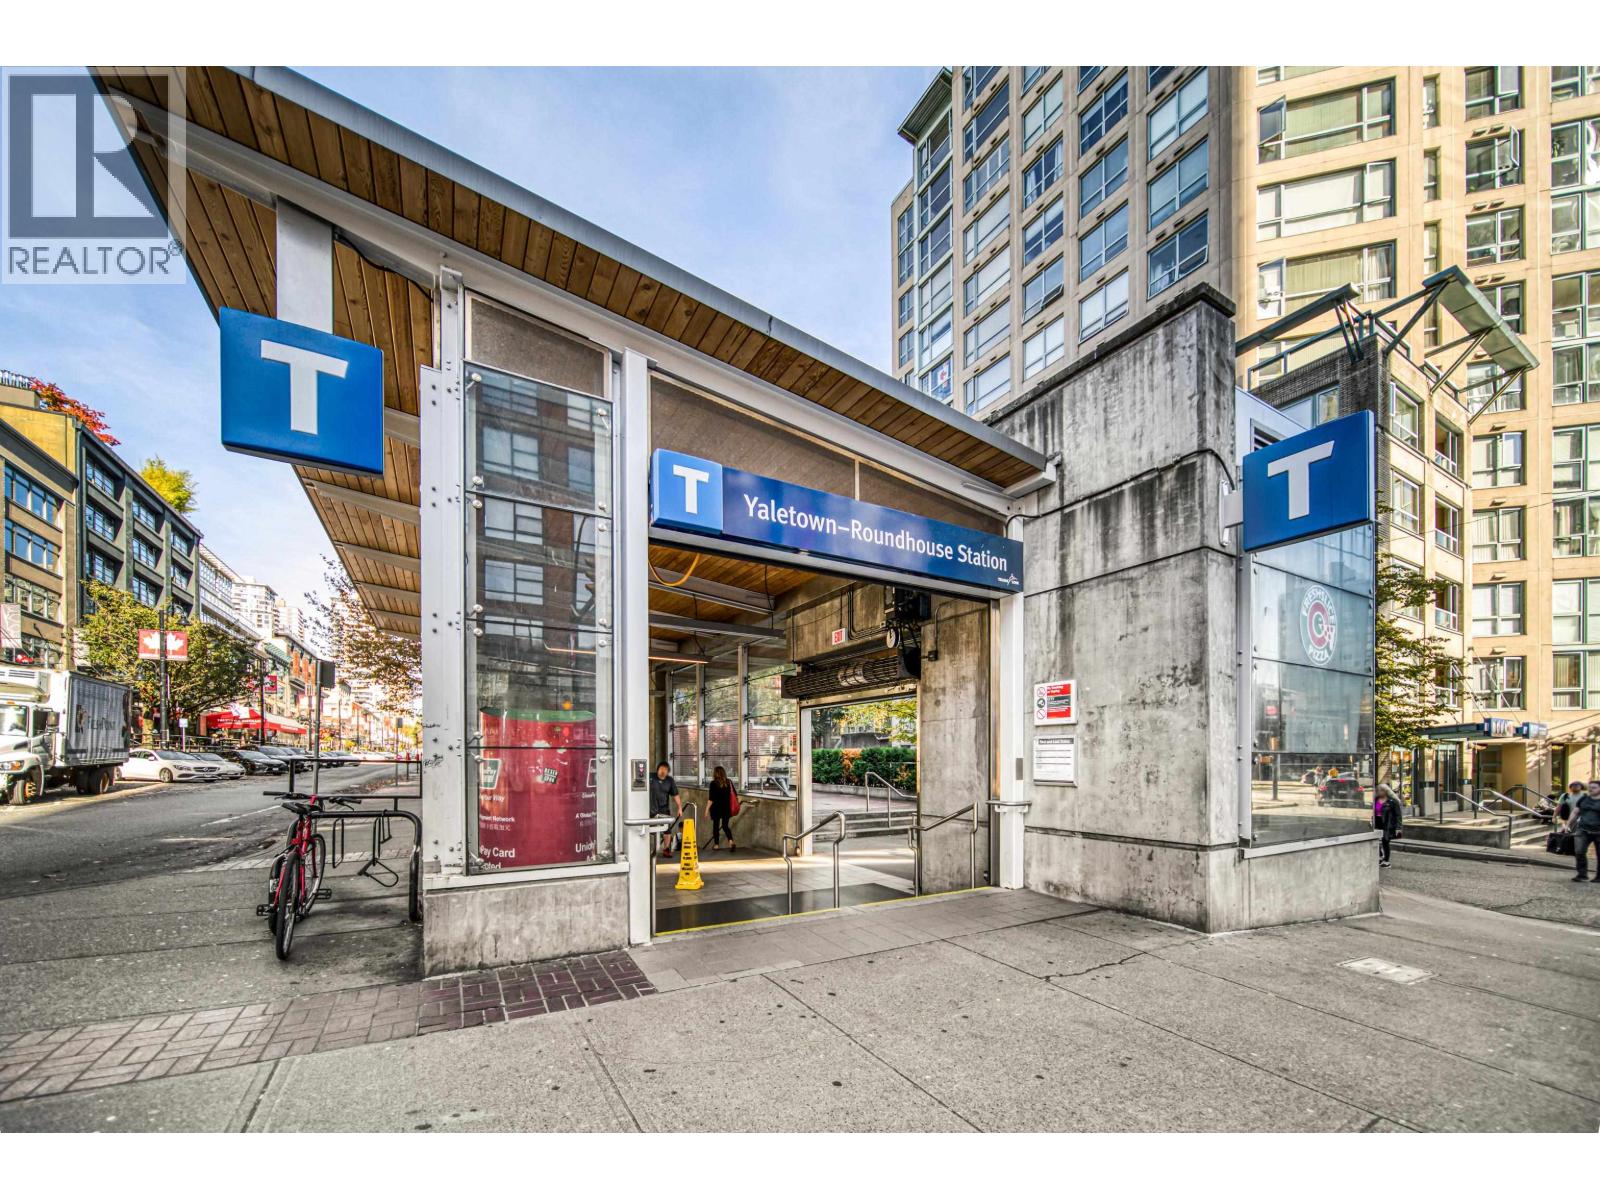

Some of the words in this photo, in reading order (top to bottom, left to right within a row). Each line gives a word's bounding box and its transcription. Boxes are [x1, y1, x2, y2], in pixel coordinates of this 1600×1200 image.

[260, 339, 349, 436] T
[672, 464, 710, 515] T
[1267, 440, 1335, 521] T
[957, 543, 1008, 572] Station
[1301, 588, 1337, 626] FRESHSLICE
[1308, 643, 1331, 662] PIZZA
[492, 847, 516, 858] Card
